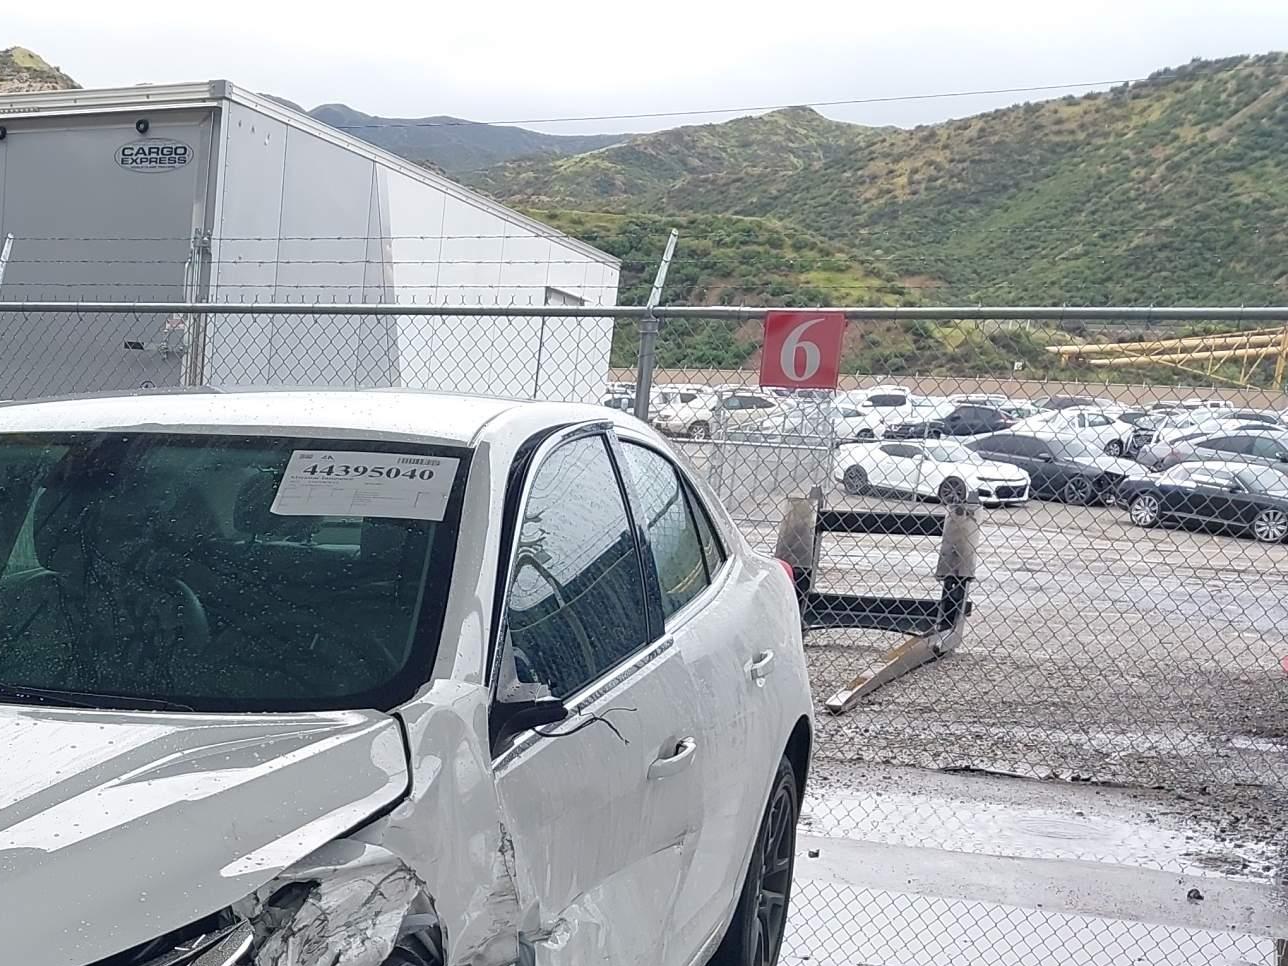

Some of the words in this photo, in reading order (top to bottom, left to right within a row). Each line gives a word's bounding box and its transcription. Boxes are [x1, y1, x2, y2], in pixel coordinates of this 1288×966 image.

[121, 145, 188, 157] CARGO
[120, 156, 187, 165] EXPRESS
[779, 318, 825, 382] 6
[303, 463, 434, 481] 44395040
